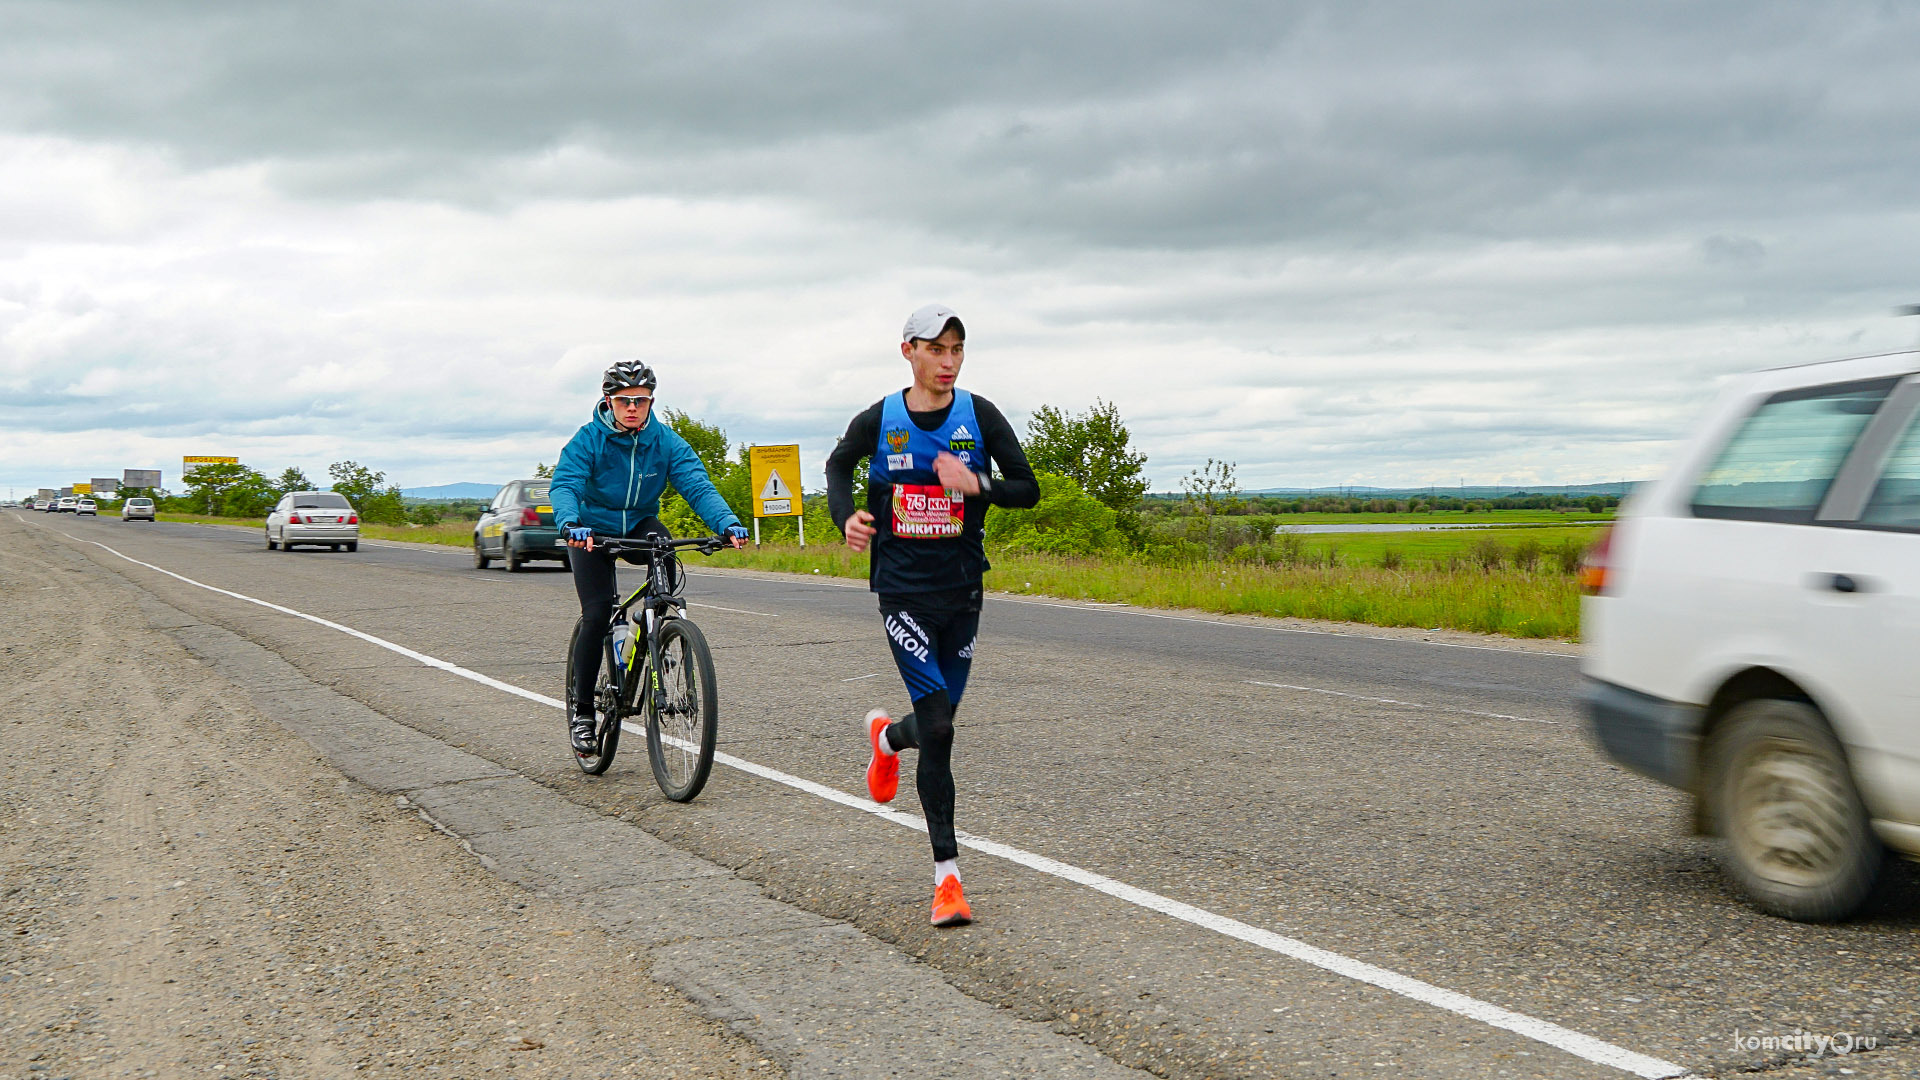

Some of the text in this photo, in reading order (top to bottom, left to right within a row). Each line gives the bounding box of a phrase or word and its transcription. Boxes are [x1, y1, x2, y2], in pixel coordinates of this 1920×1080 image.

[906, 494, 926, 510] 75
[897, 522, 961, 534] НИКИТИН
[885, 615, 929, 663] LUKOIL
[899, 611, 929, 645] SCANIA
